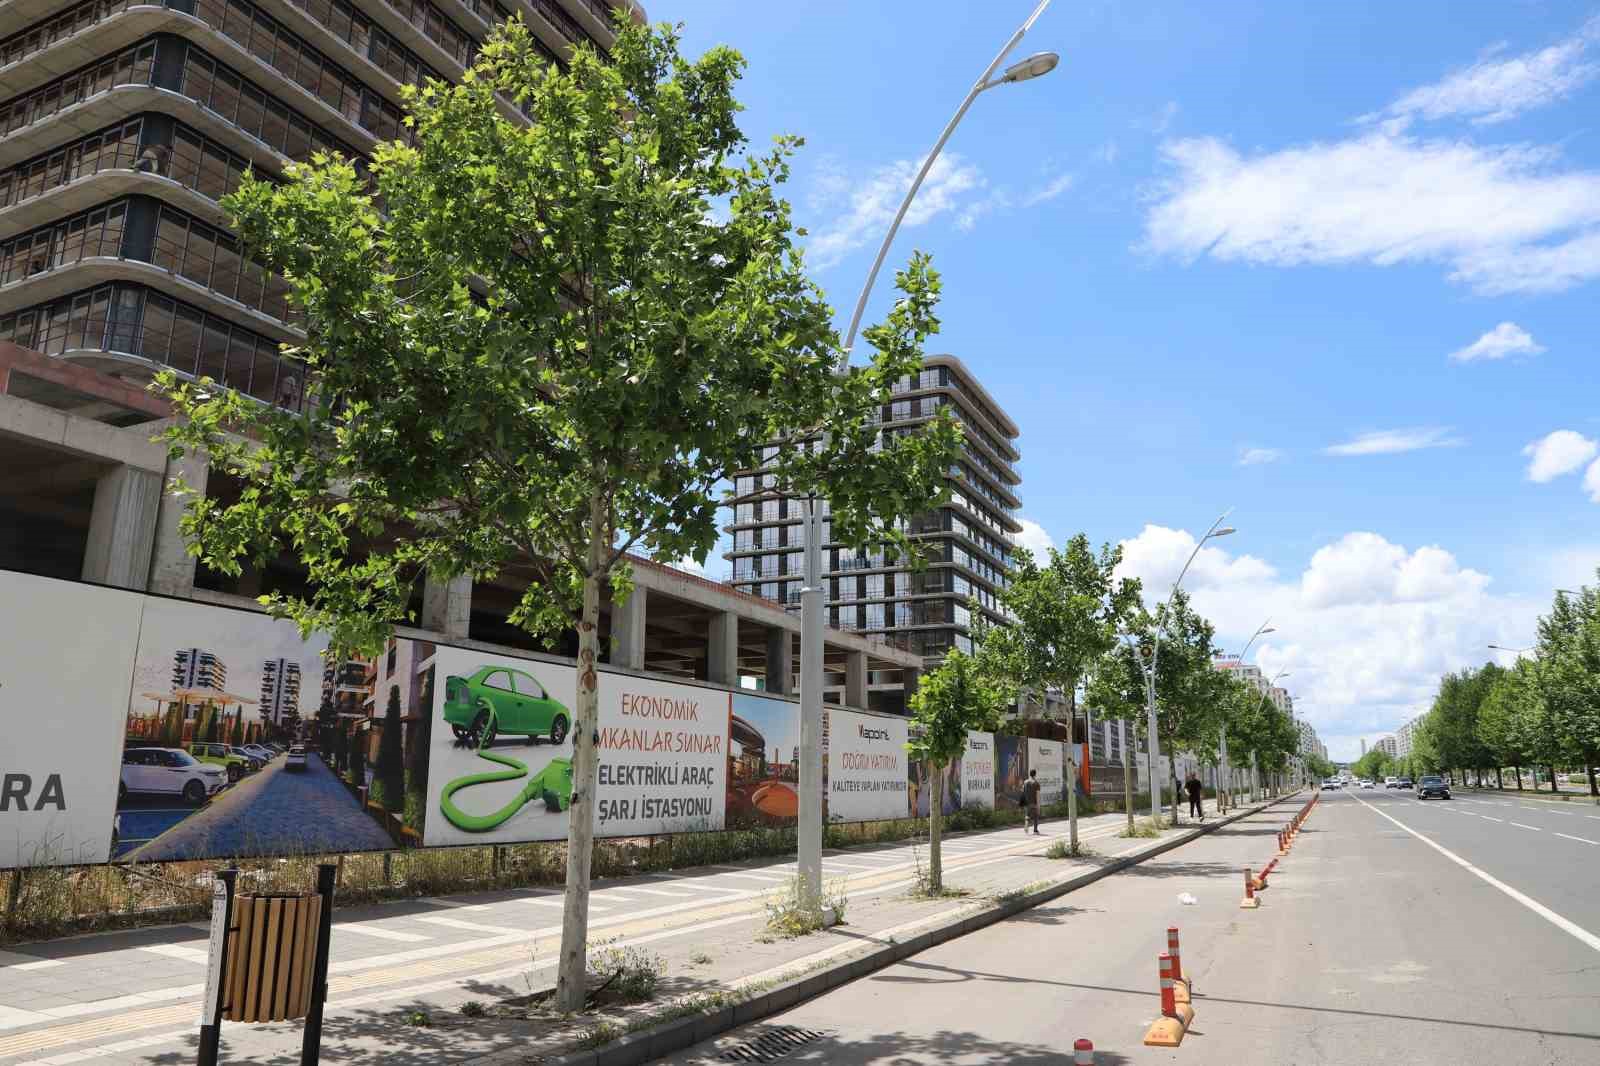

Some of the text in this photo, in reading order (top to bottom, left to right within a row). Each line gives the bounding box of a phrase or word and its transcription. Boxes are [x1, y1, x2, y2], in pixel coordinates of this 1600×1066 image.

[594, 727, 721, 754] MKANLAR SUNAR
[599, 761, 714, 789] ELEKTRİKLİ ARAÇ
[599, 794, 712, 825] ŞARJ İSTASYONU
